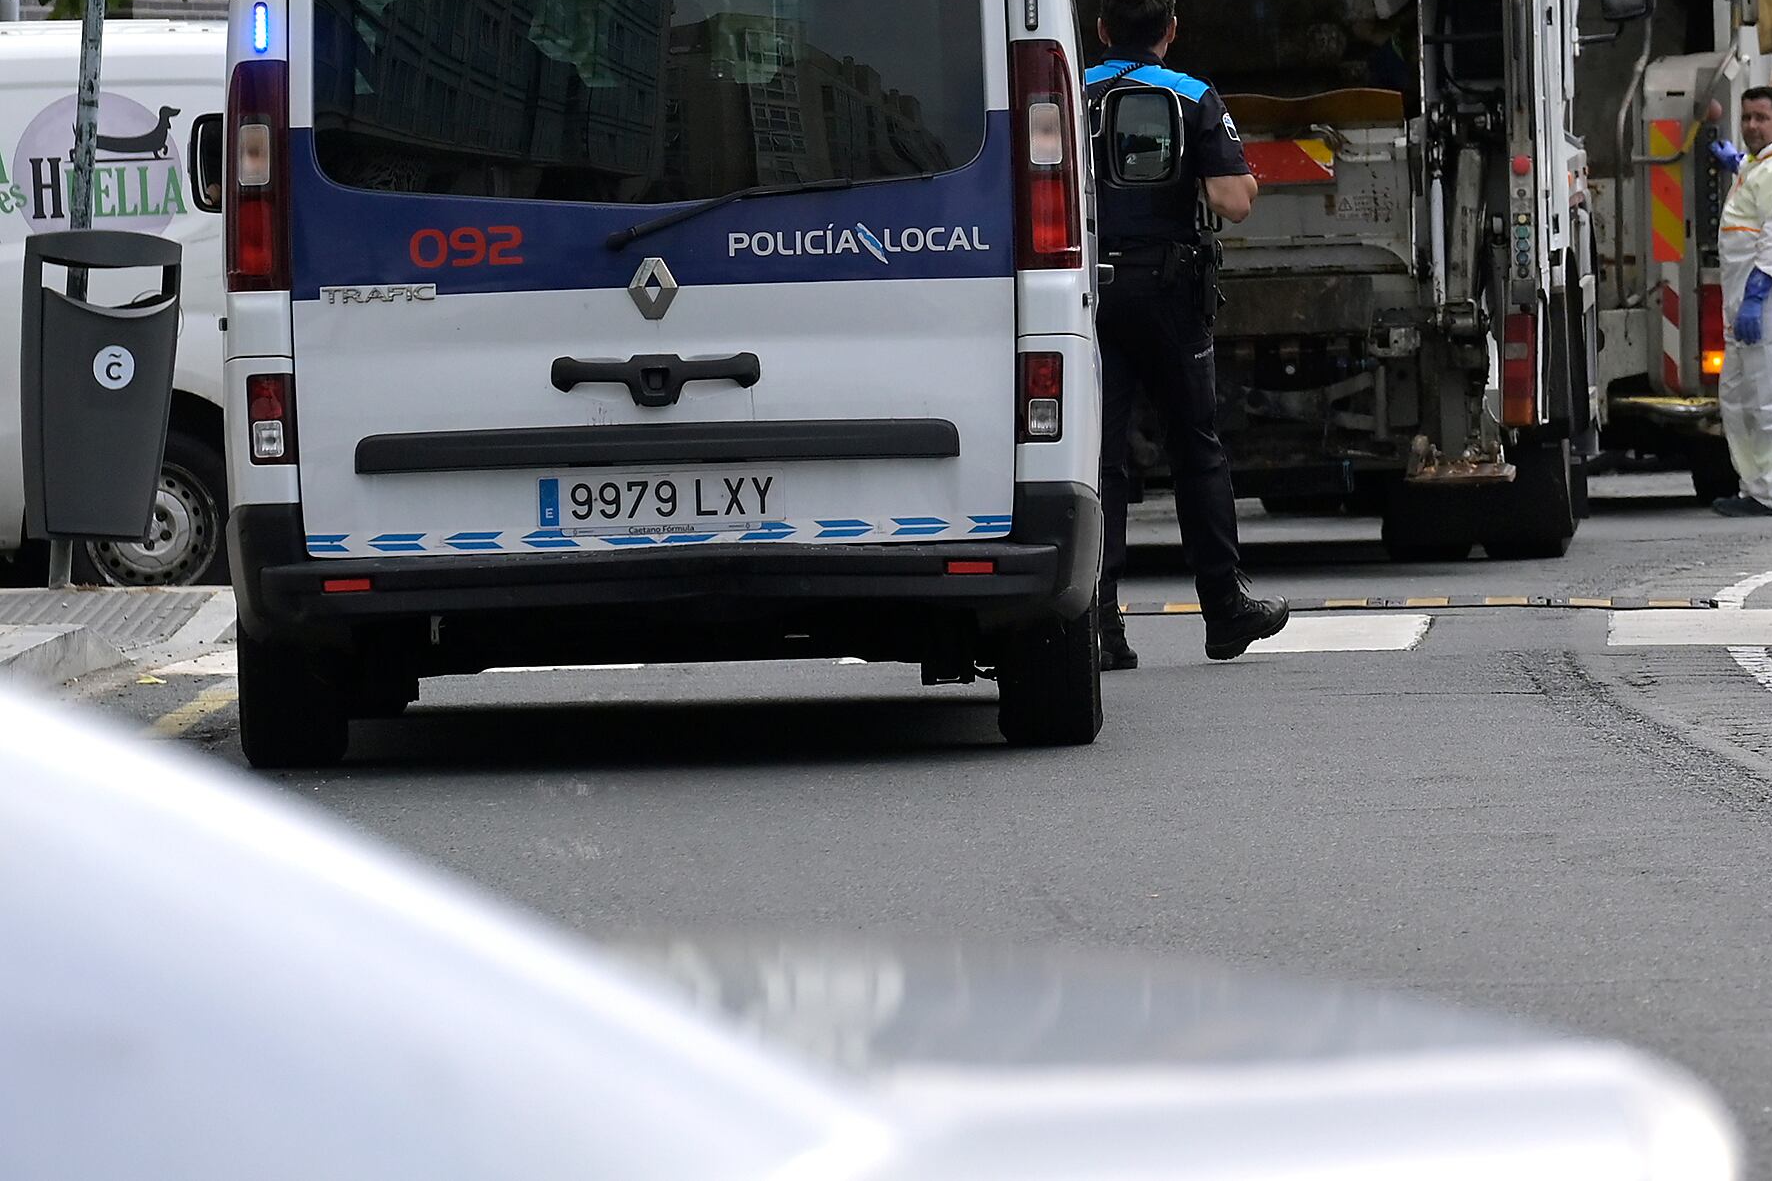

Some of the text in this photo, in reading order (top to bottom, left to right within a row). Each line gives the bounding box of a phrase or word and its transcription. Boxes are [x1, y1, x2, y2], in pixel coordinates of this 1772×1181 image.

[29, 157, 188, 220] HELLA
[409, 225, 524, 269] 092
[728, 223, 990, 257] POLICÍA LOCAL
[321, 285, 436, 305] TRAFIC
[546, 476, 774, 520] E 9979 LXY
[628, 524, 695, 535] Caetano Fórmula
